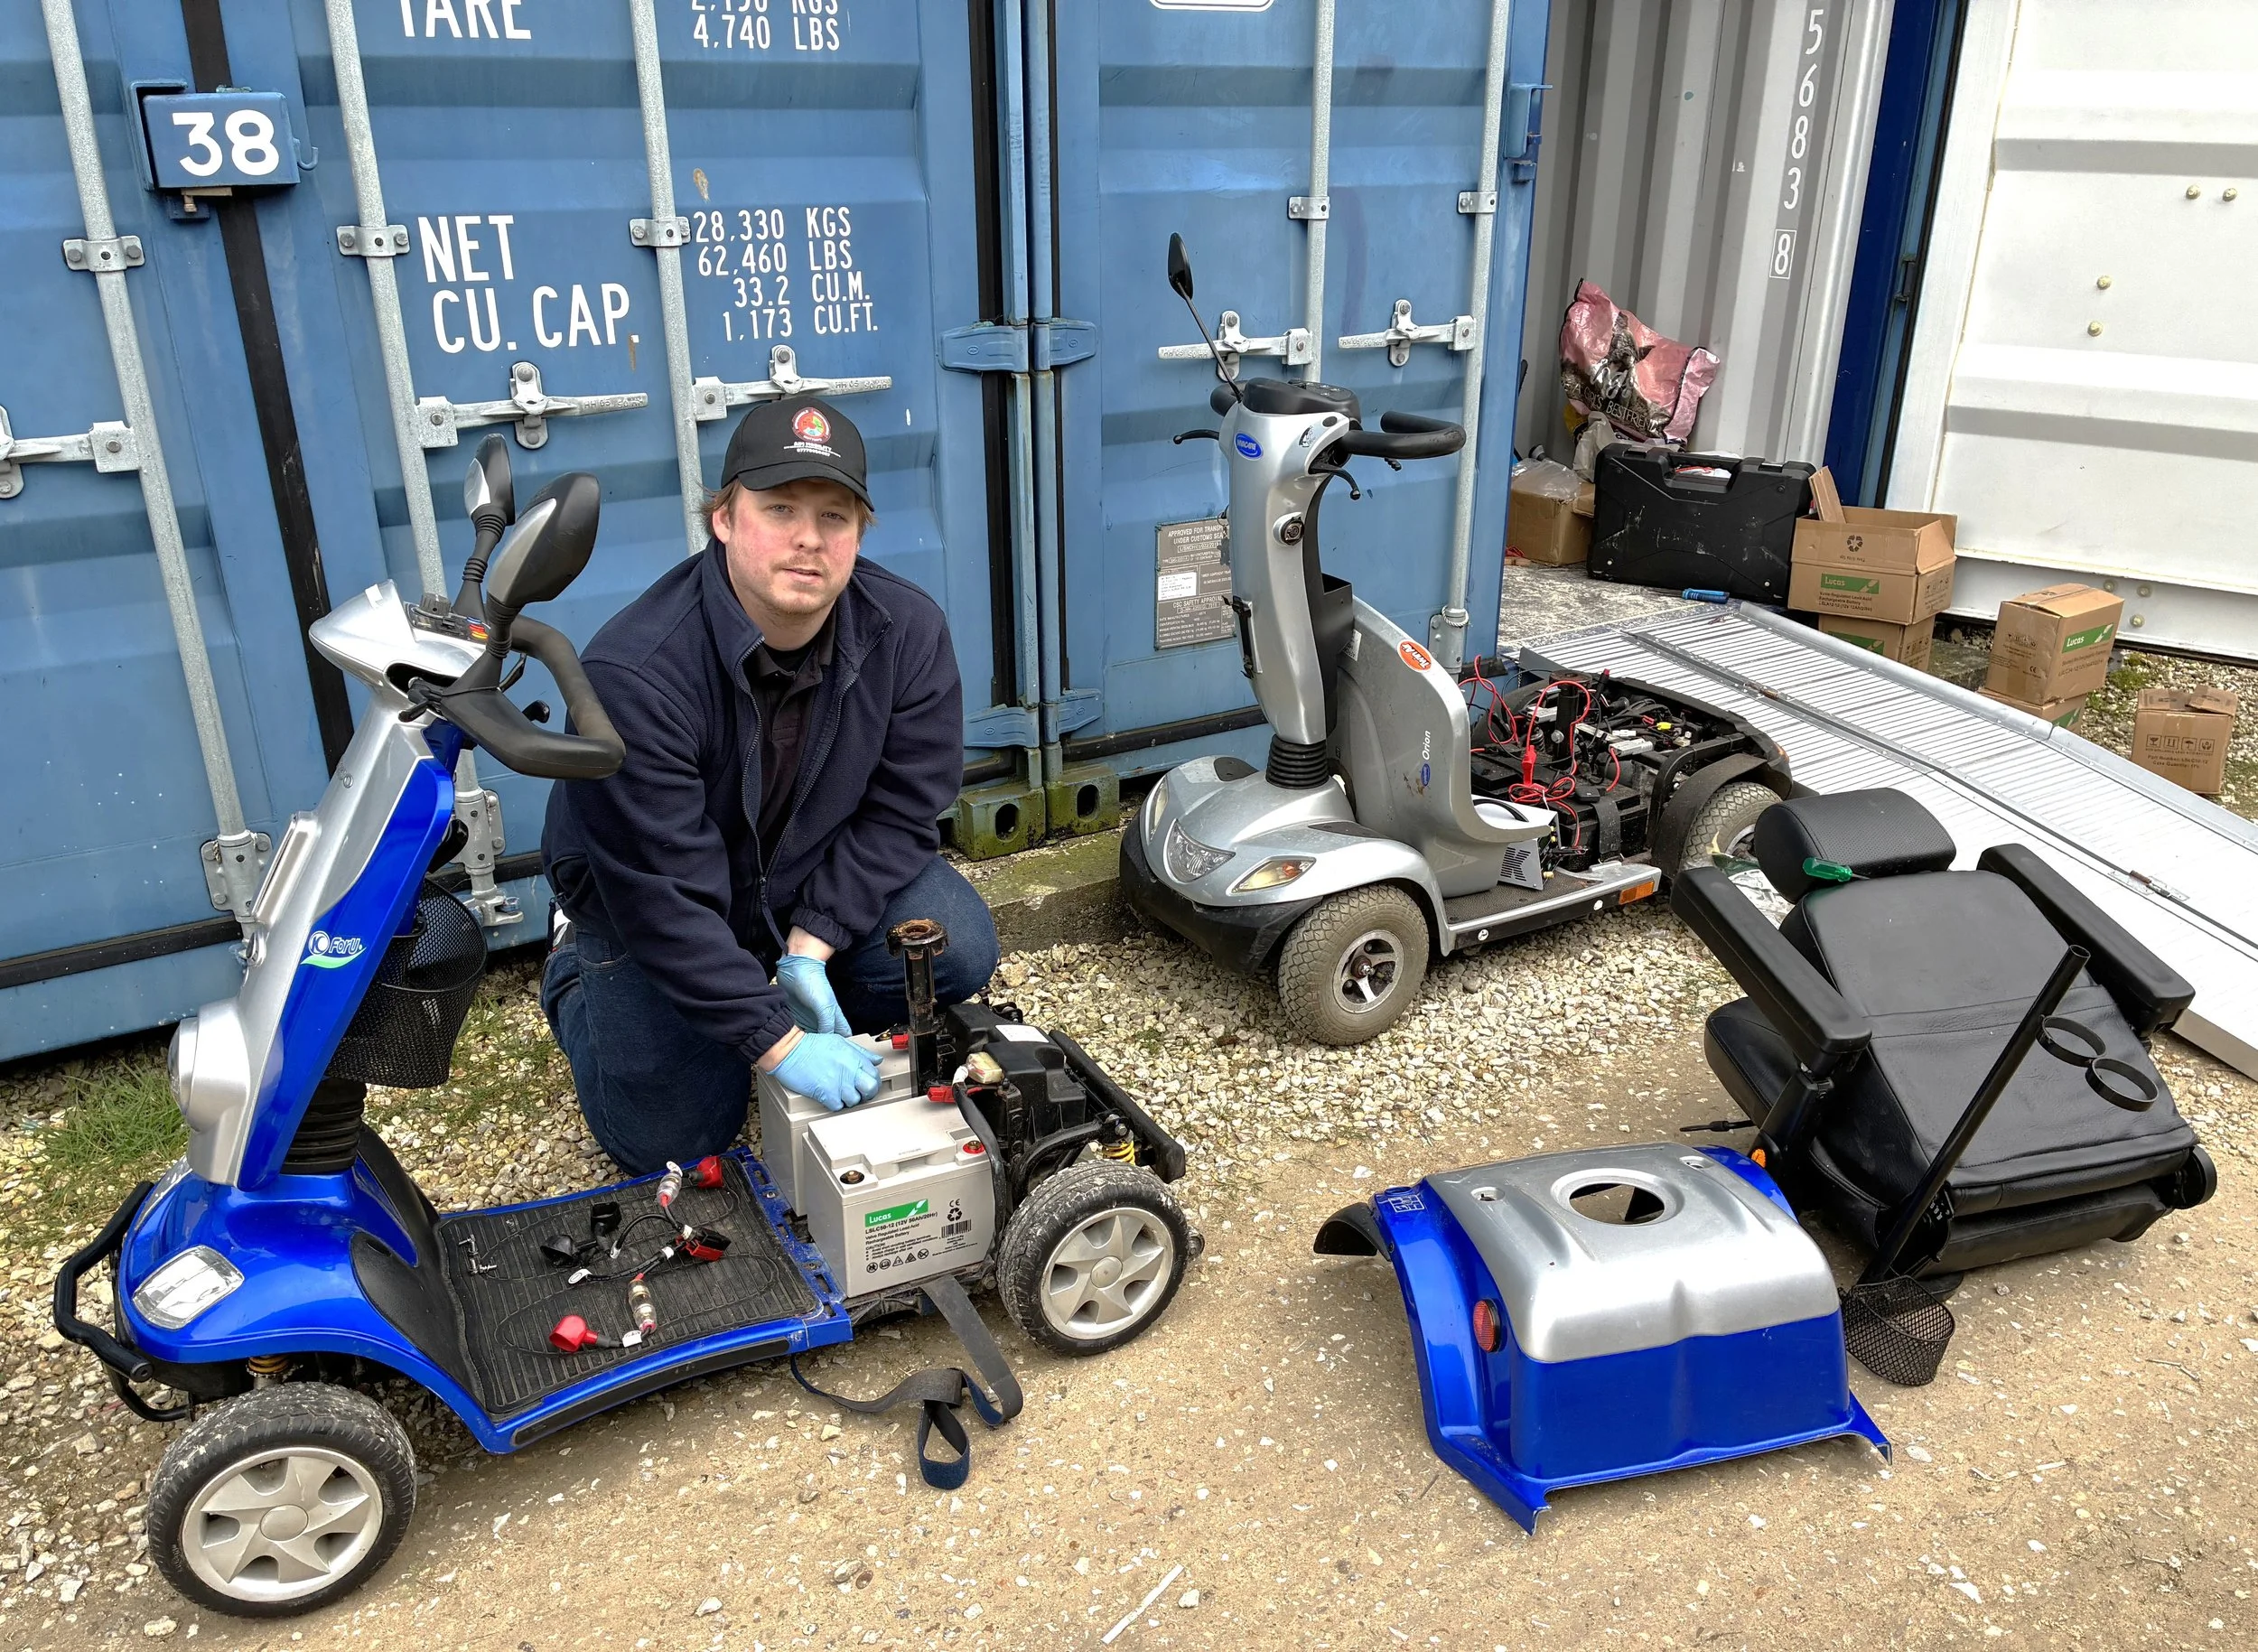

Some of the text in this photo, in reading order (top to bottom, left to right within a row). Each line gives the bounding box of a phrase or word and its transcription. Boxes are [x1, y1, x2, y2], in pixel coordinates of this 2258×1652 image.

[693, 14, 840, 51] 4,740 LBS
[172, 109, 279, 176] 38
[693, 207, 851, 242] 28,330 KGS
[417, 215, 514, 283] NET
[698, 239, 853, 276] 62,460 LBS
[1775, 233, 1791, 275] 8
[732, 271, 870, 307] 33.2 CU.M.
[433, 283, 639, 353] CU. CAP.
[723, 303, 878, 341] 1,173 CU.FT.
[1824, 576, 1845, 586] Lucas
[1183, 599, 1199, 607] SAFETY
[1200, 595, 1223, 604] APPROVAL
[2067, 635, 2085, 647] Lucas
[1422, 730, 1431, 761] Orion
[869, 1212, 892, 1224] Lucas
